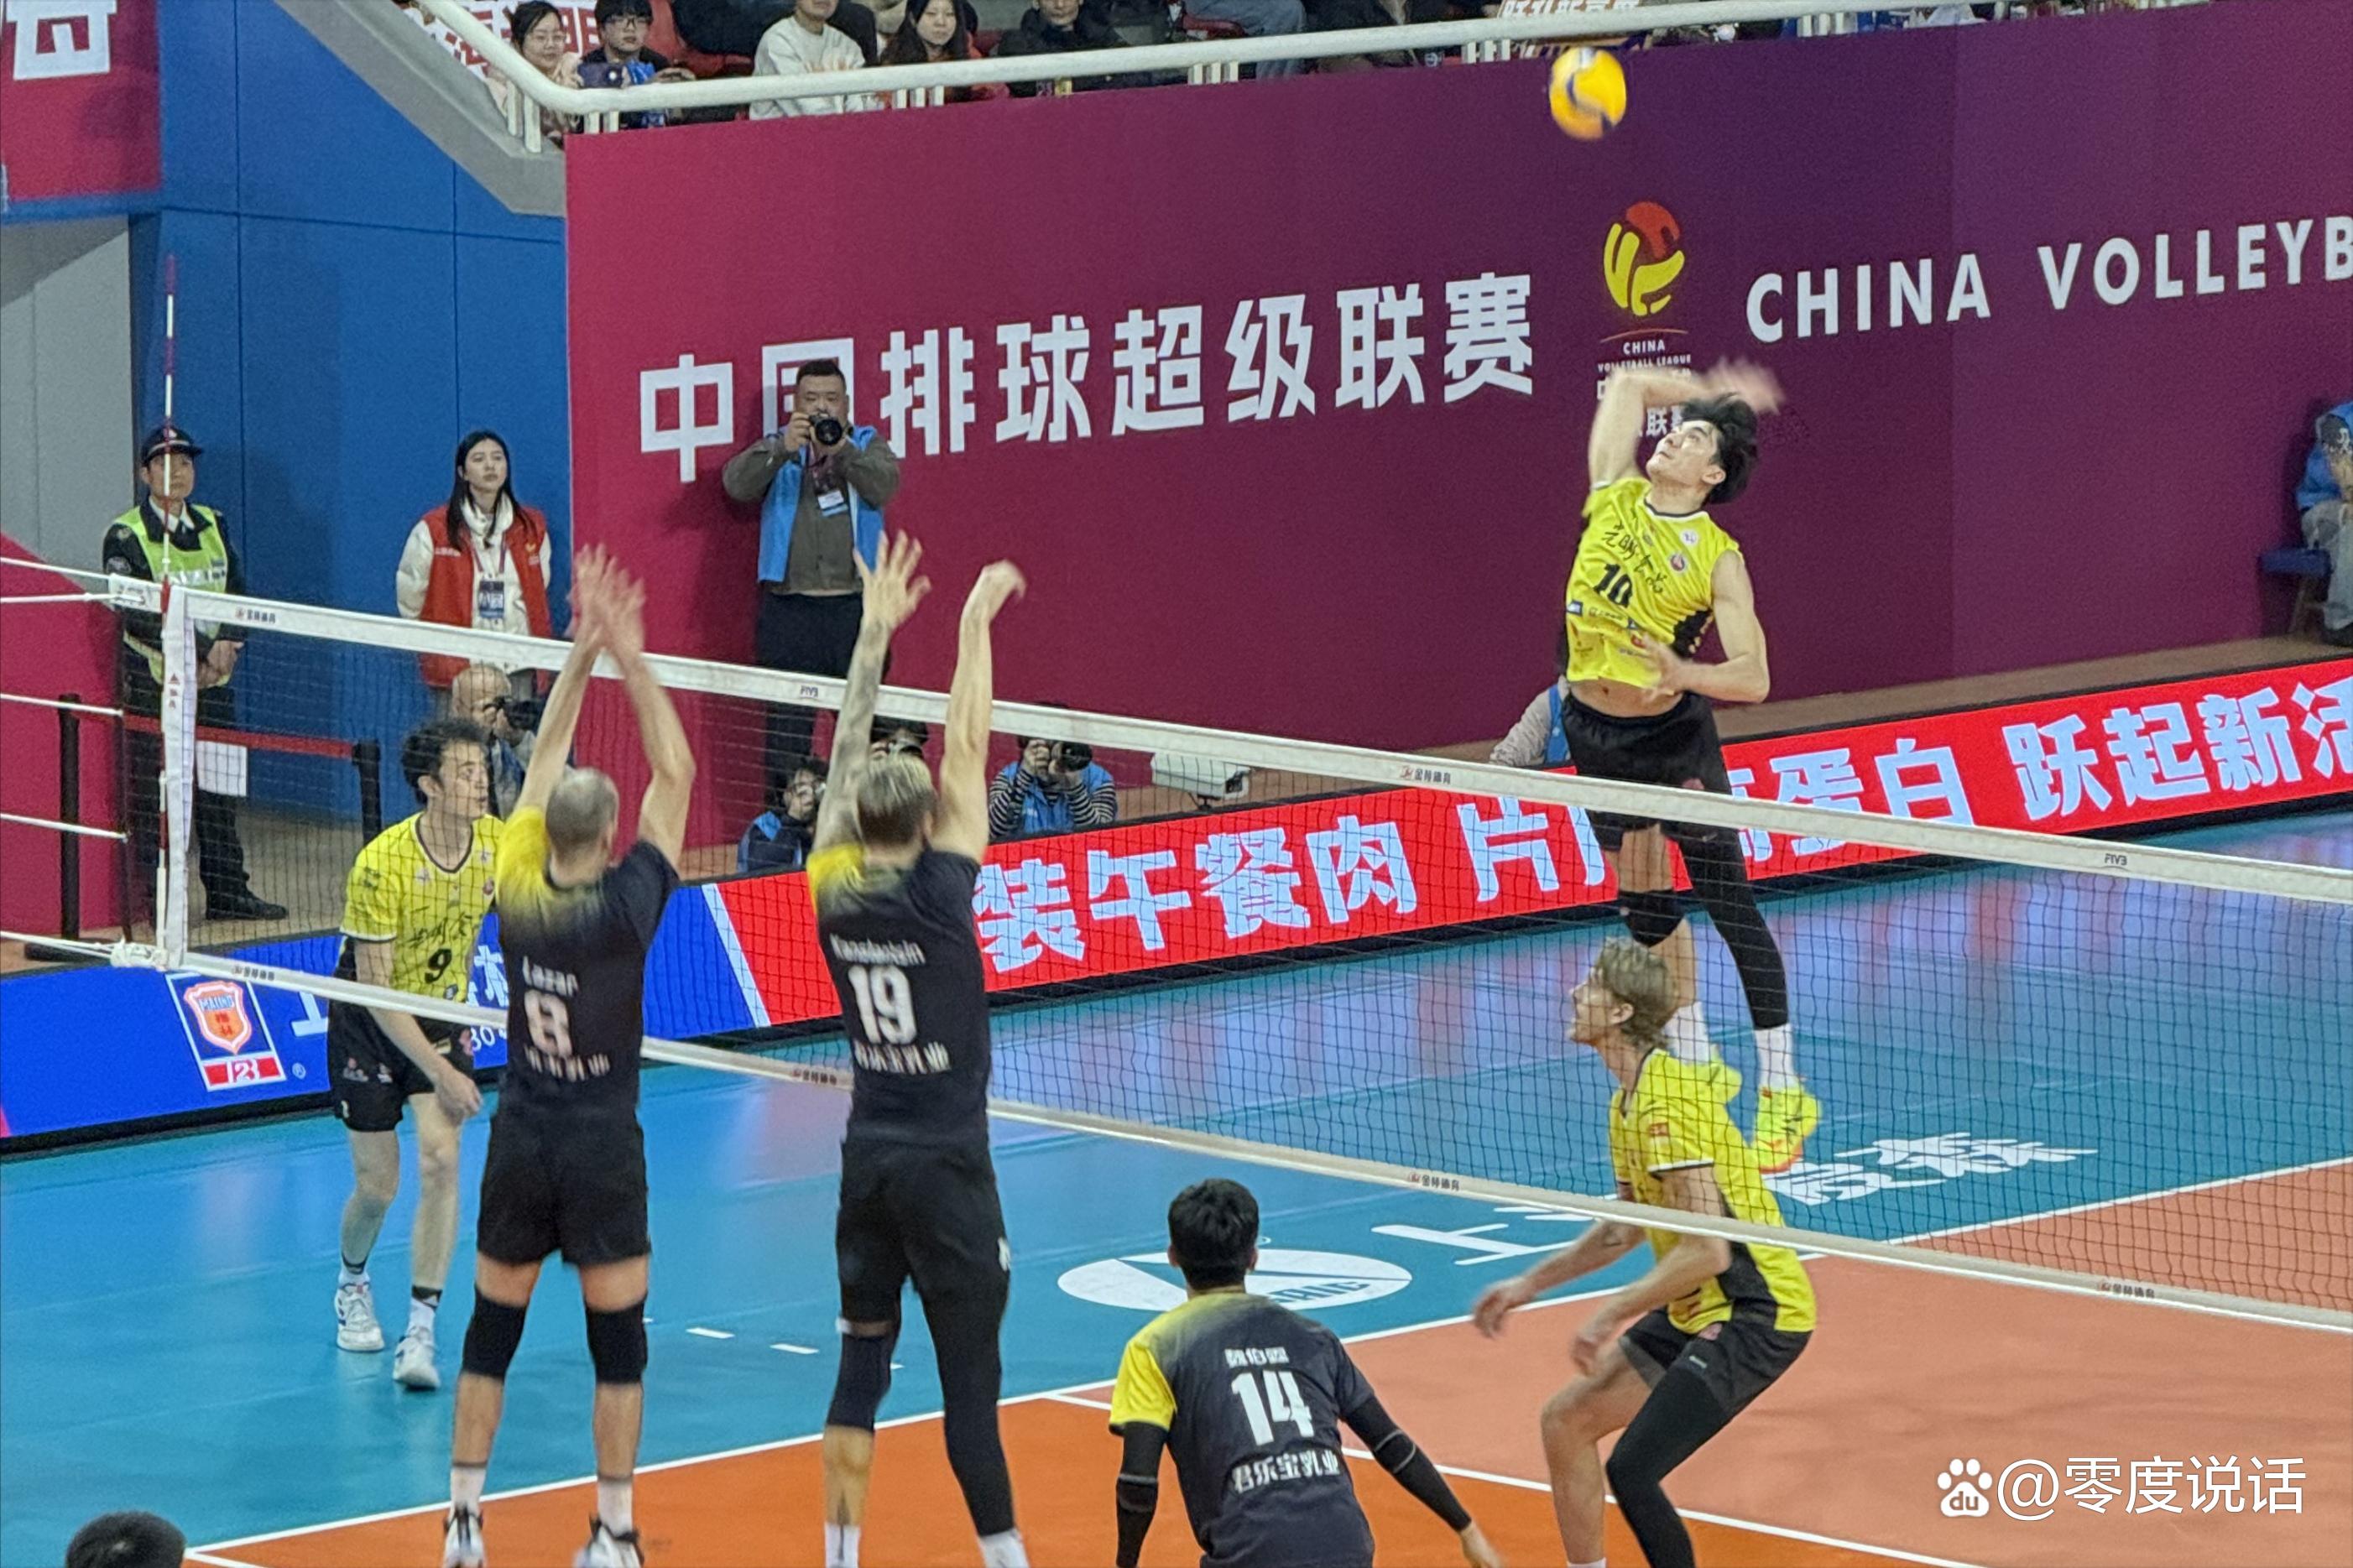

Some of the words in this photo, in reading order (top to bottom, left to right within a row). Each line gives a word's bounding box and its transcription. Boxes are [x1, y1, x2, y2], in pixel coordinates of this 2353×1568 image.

[1746, 253, 1991, 343] CHINA
[2037, 215, 2353, 311] VOLLEYB
[640, 271, 1534, 484] 中国排球超级联赛
[1623, 340, 1666, 355] CHINA
[1656, 354, 1692, 367] LEAGUE
[1593, 563, 1634, 608] 10
[971, 814, 1419, 975] 装午餐肉
[425, 949, 452, 984] 9
[524, 988, 573, 1060] 8
[847, 964, 918, 1045] 19
[1230, 1370, 1315, 1447] 14
[1231, 1449, 1341, 1494] 君乐宝乳业
